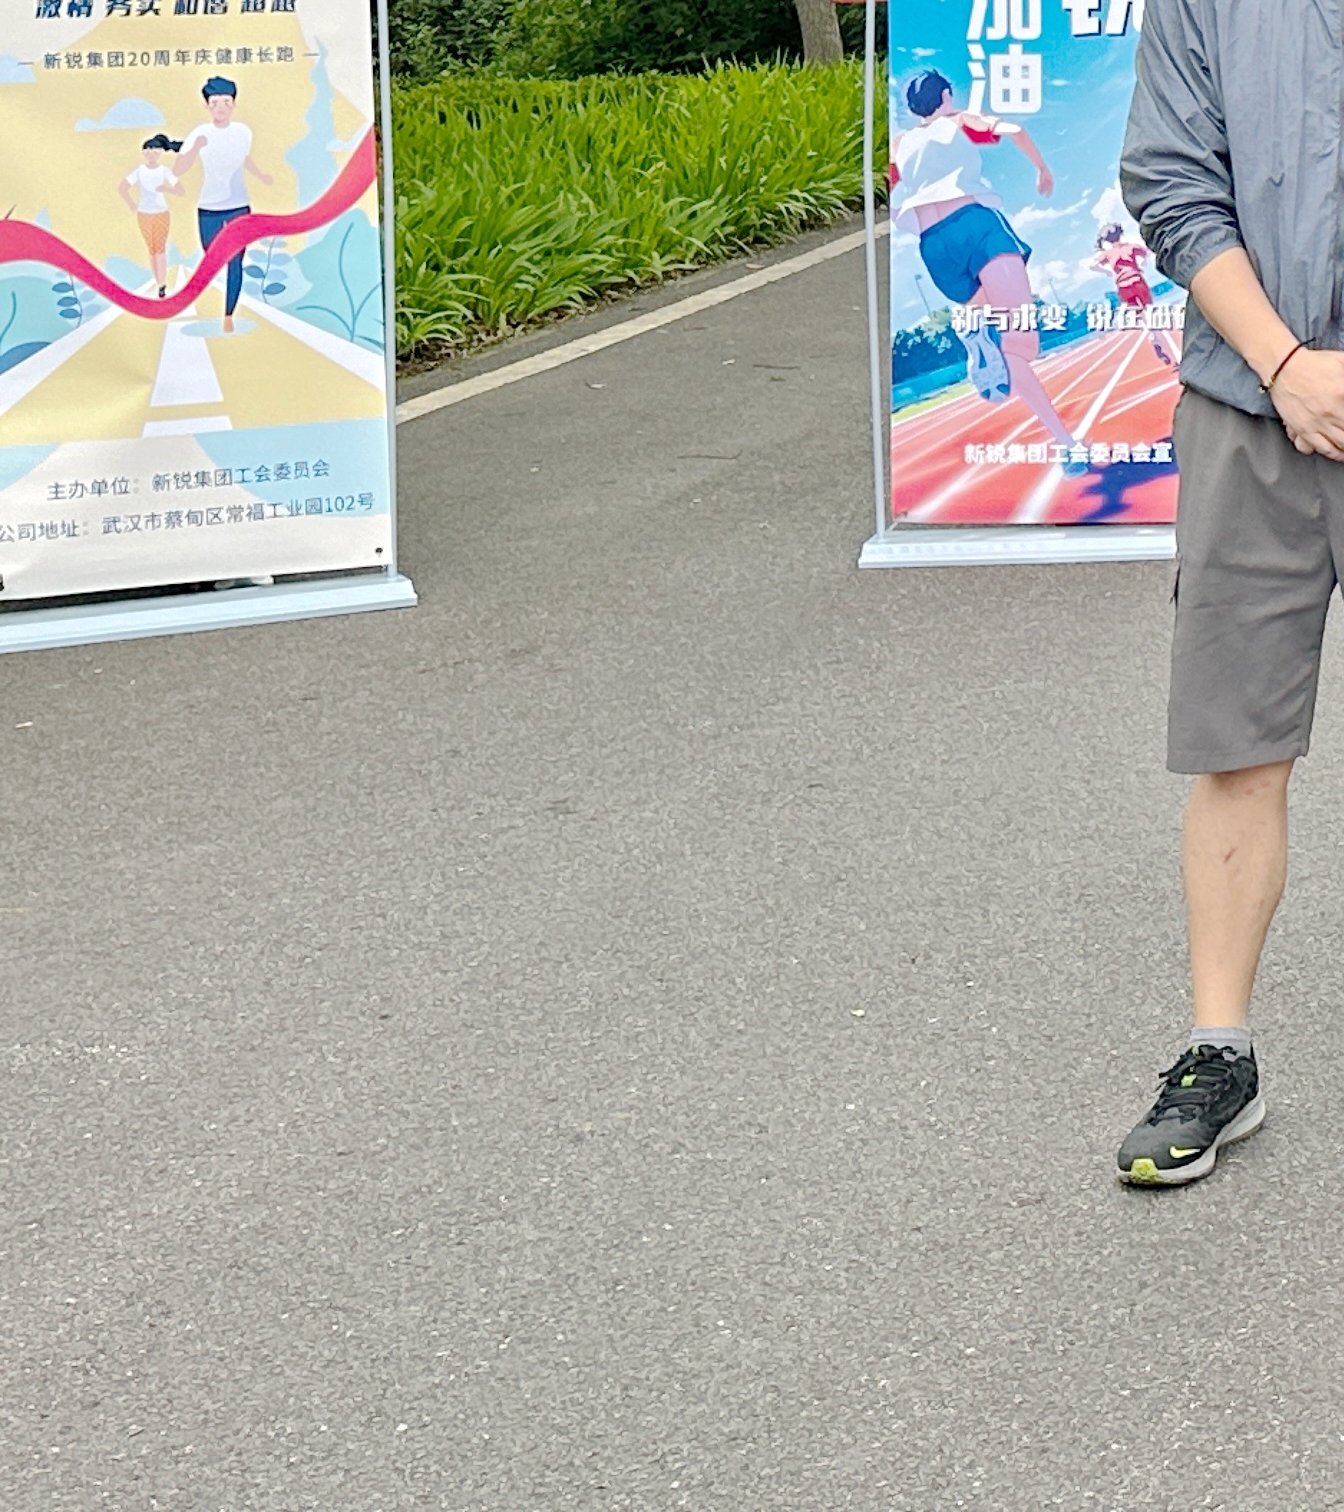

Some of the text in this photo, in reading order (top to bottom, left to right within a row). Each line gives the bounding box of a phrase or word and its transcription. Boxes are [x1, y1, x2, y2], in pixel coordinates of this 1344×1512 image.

[43, 46, 295, 70] 新锐集团20周年庆健康长跑
[964, 442, 1173, 465] 新锐集团工会委员会宣
